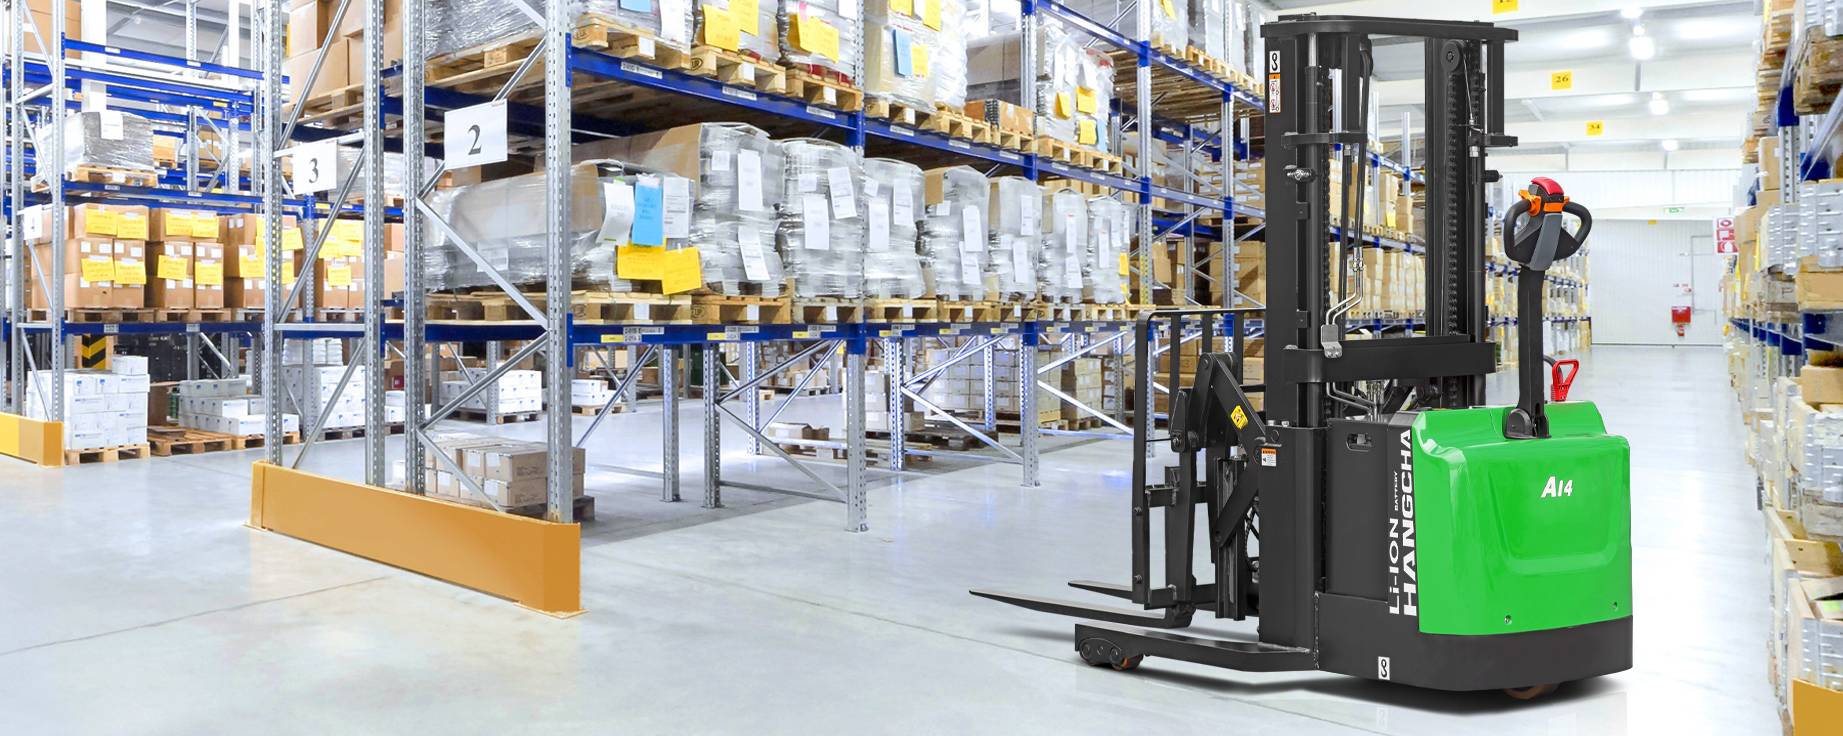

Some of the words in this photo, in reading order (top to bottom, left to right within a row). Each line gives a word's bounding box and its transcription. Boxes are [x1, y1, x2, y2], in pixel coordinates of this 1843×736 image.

[308, 157, 320, 184] 3
[467, 124, 482, 156] 2
[1400, 429, 1417, 617] HANGCHA
[1389, 517, 1400, 615] Li-ION
